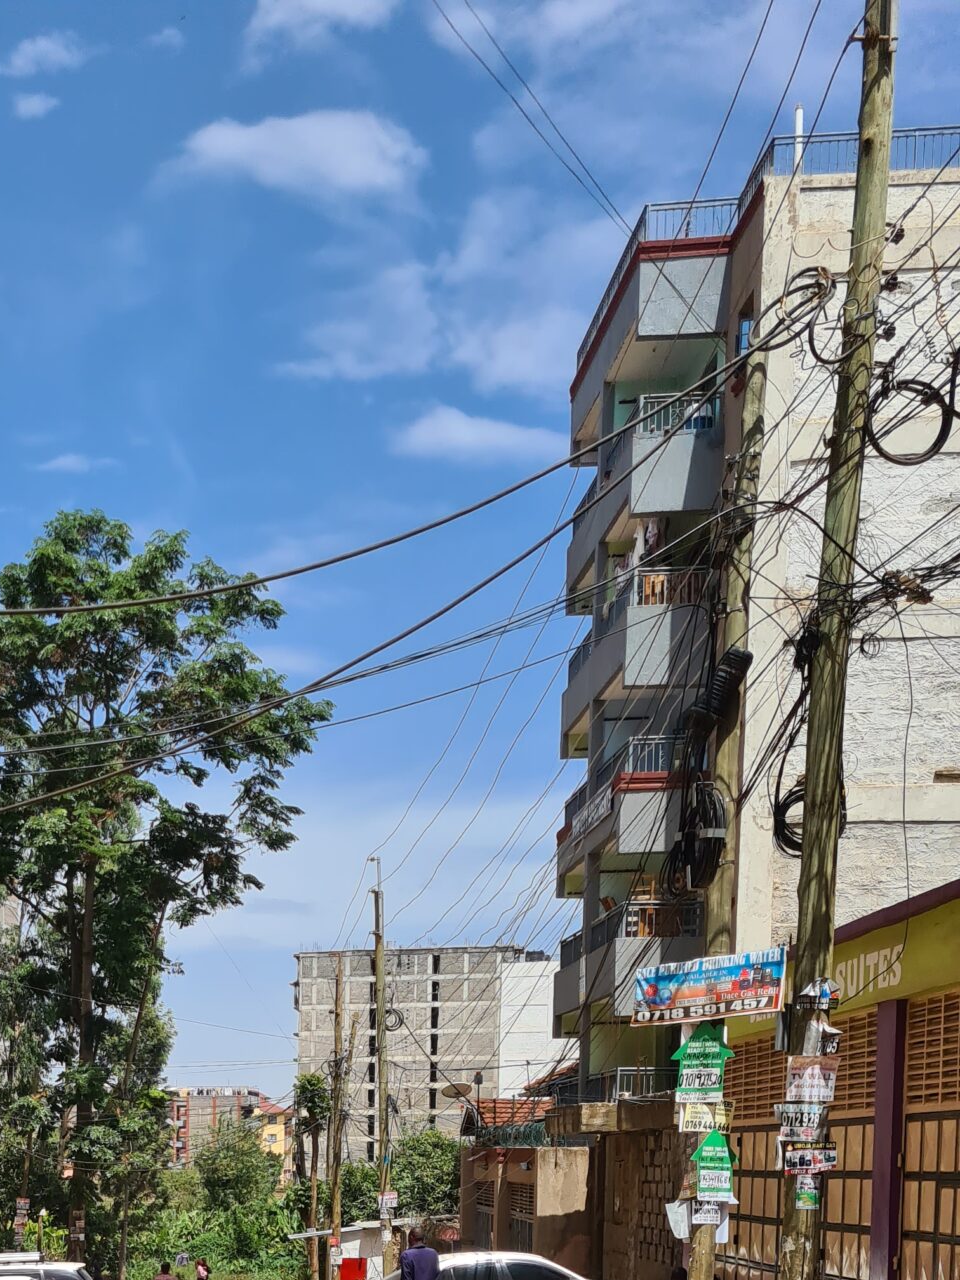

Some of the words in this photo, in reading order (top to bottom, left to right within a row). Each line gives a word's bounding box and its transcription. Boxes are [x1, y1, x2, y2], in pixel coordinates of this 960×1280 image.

[702, 953, 746, 969] DRINKING
[750, 949, 781, 962] WATER
[835, 944, 903, 1000] SUITES
[740, 990, 755, 998] Gas
[637, 1008, 684, 1022] 0718
[690, 1003, 726, 1016] 591
[731, 997, 769, 1011] 457
[808, 1073, 833, 1081] WALL
[685, 1120, 702, 1129] 0769
[782, 1112, 801, 1127] 0712
